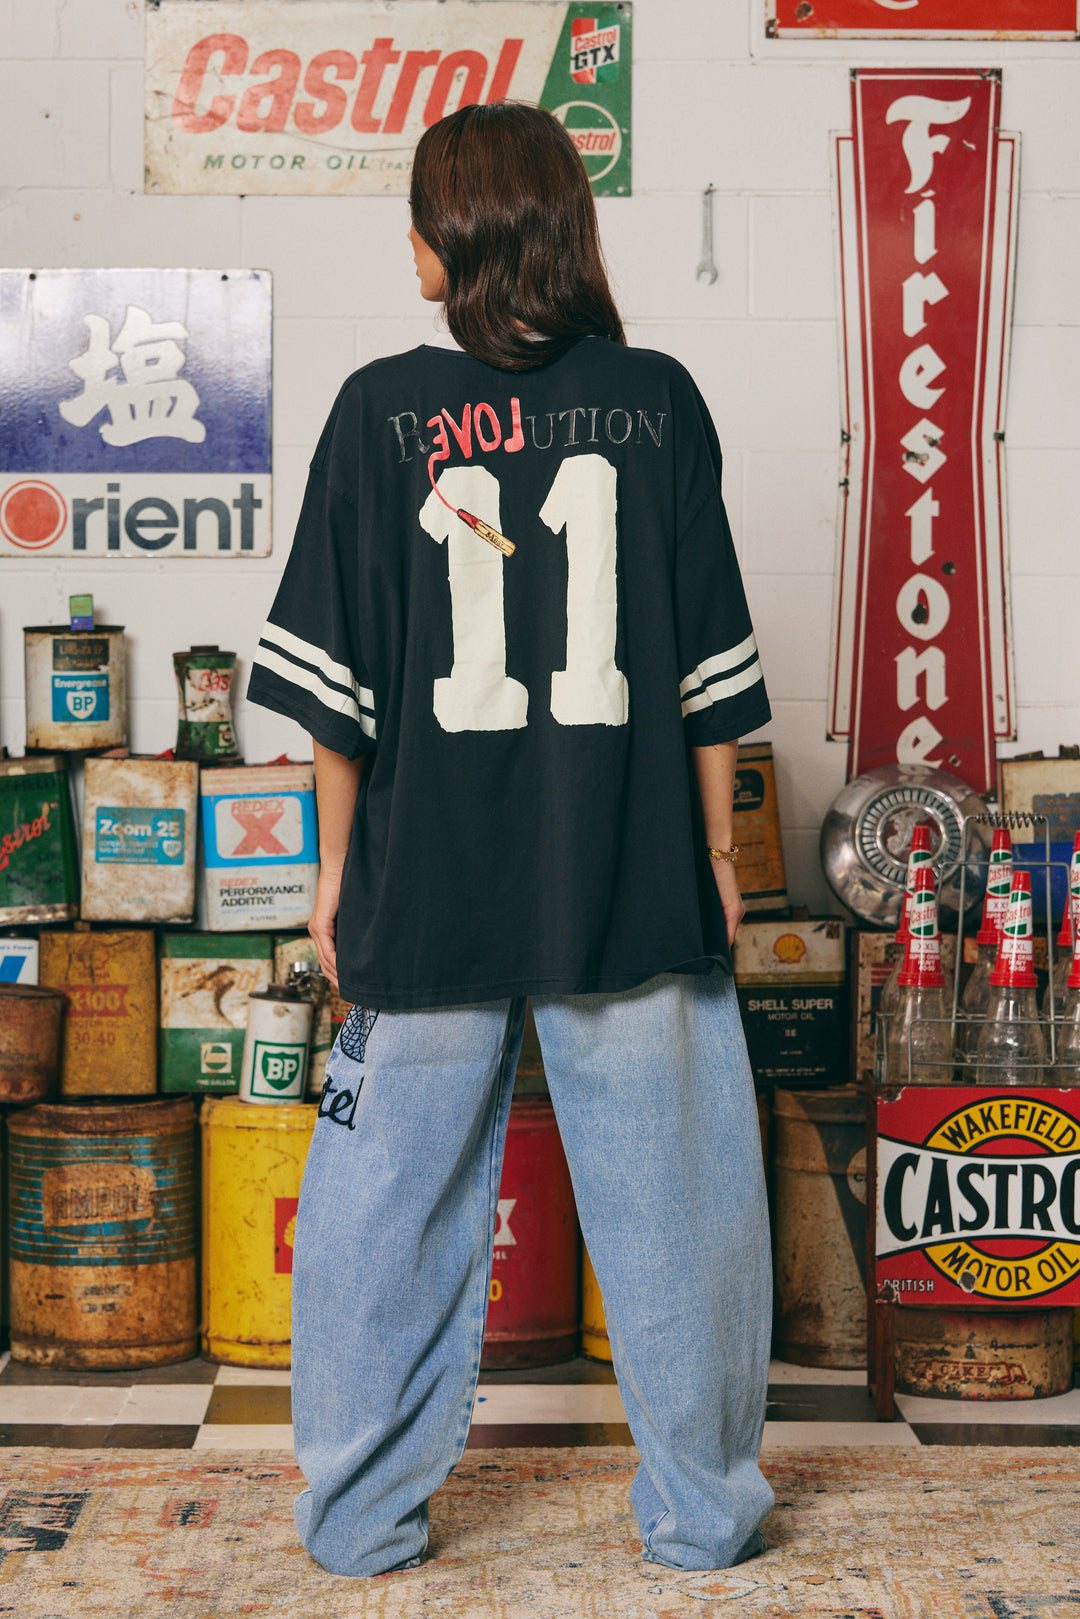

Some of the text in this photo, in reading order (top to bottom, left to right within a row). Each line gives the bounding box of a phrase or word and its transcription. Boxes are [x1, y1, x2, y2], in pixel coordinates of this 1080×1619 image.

[574, 28, 617, 52] Castrol
[574, 43, 615, 71] GTX
[172, 33, 524, 134] Castrol
[571, 132, 617, 151] strol
[203, 155, 306, 170] MOTOR
[326, 155, 370, 170] OIL
[58, 305, 206, 447] 塩
[885, 95, 972, 769] Firestone
[72, 697, 94, 711] BP
[231, 799, 285, 814] REDEX
[100, 819, 180, 837] Zoom 25
[219, 877, 258, 888] REDEX
[220, 884, 305, 897] PERFORMANCE
[221, 896, 275, 907] ADDITIVE
[748, 999, 833, 1011] SHELL SUPER
[768, 1012, 815, 1021] MOTOR OIL
[267, 1057, 297, 1081] BP
[940, 1103, 1077, 1150] WAKEFIELD
[52, 1182, 146, 1221] AMPOL
[942, 1245, 1080, 1292] MOTOR OIL
